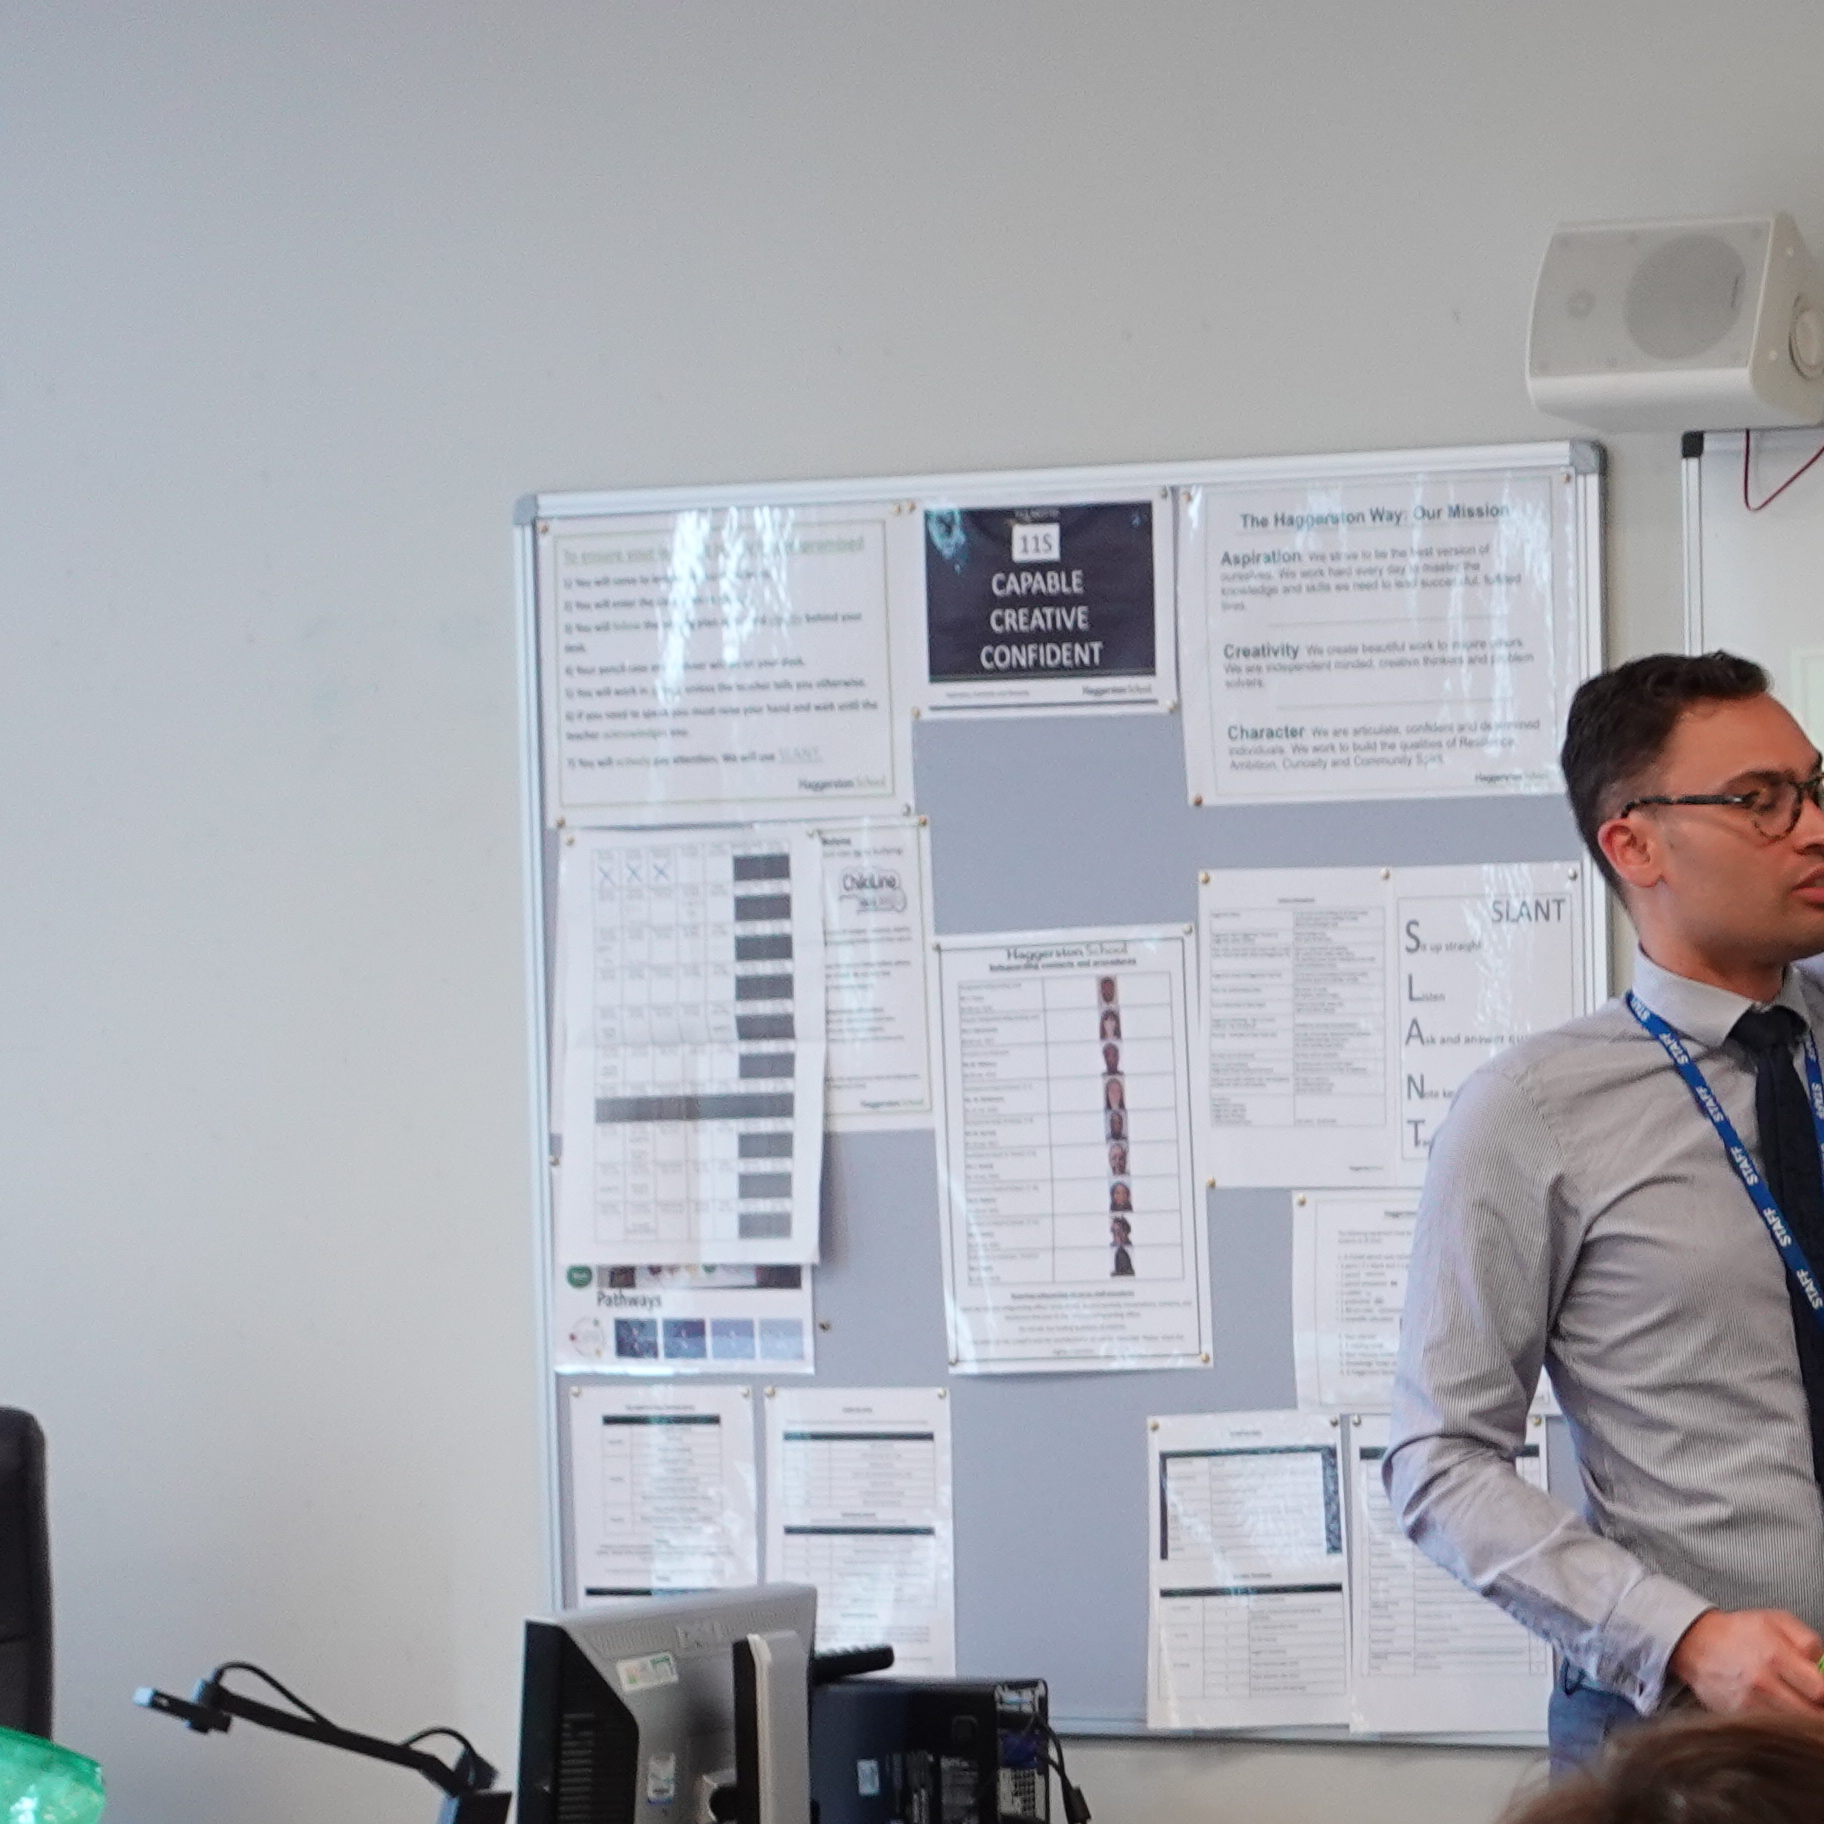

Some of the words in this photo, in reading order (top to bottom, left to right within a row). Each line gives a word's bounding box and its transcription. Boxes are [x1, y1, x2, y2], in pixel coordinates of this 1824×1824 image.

[1239, 513, 1269, 529] The
[1413, 504, 1443, 521] Our
[1446, 501, 1511, 519] Mission
[1020, 532, 1053, 555] 11S
[991, 570, 1085, 597] CAPABLE
[990, 605, 1090, 634] CREATIVE
[979, 641, 1104, 670] CONFIDENT
[1222, 642, 1301, 661] Creativity
[1227, 724, 1306, 741] Character
[1490, 898, 1567, 924] SLANT
[1658, 1032, 1689, 1065] STAFF
[1694, 1085, 1724, 1122] STAFF
[1730, 1145, 1759, 1187] STAFF
[1762, 1206, 1792, 1248] STAFF
[1796, 1268, 1824, 1310] STAFF
